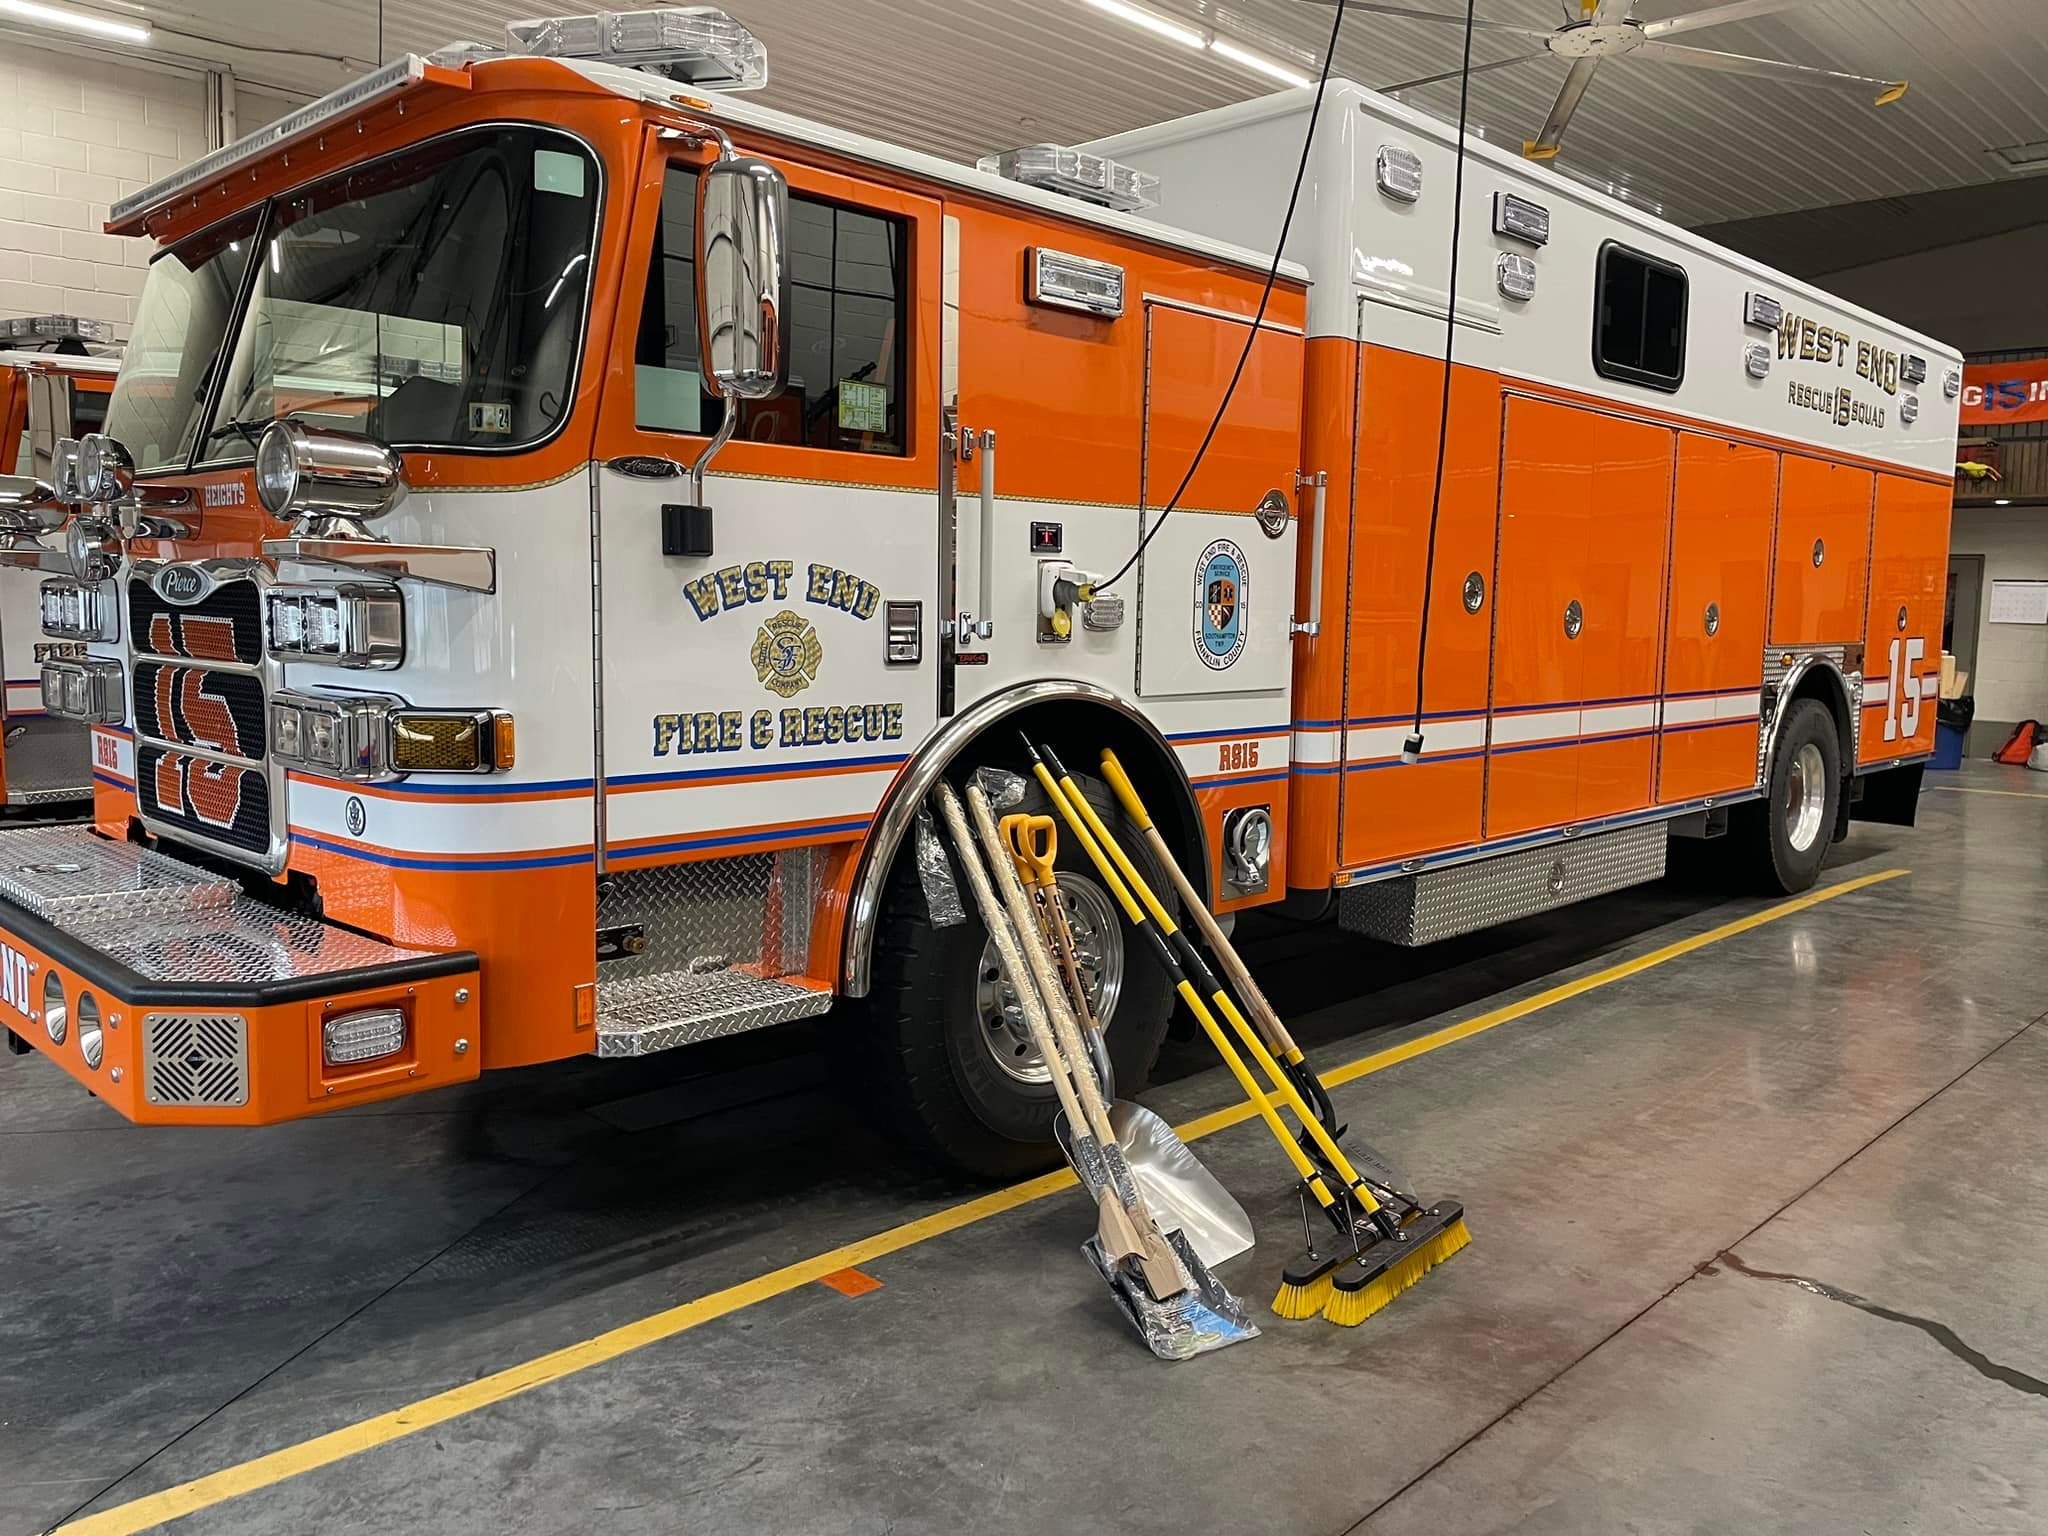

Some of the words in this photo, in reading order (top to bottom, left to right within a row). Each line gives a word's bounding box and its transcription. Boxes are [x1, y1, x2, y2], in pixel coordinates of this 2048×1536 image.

[1777, 311, 1850, 367] WEST
[1856, 340, 1898, 396] END
[499, 408, 510, 428] 24
[1788, 381, 1833, 414] RESCUE
[1832, 386, 1852, 427] 15
[1851, 400, 1885, 428] SQUAD
[205, 482, 246, 507] HEIGHTS
[166, 570, 197, 595] Pierce
[1197, 561, 1206, 586] WEST
[1204, 546, 1217, 561] END
[1217, 543, 1230, 553] FIRE
[1236, 553, 1247, 586] RESCUE
[683, 560, 793, 622] WEST
[806, 563, 880, 620] END
[772, 619, 803, 630] RESCUE
[1195, 630, 1221, 667] FRANKLIN
[1223, 630, 1245, 666] COUNTY
[771, 677, 802, 689] COMPANY
[1883, 637, 1925, 741] 15
[150, 613, 246, 830] 15
[653, 711, 742, 757] FIRE
[750, 709, 773, 749] &
[779, 703, 903, 747] RESCUE
[0, 940, 30, 1017] ND
